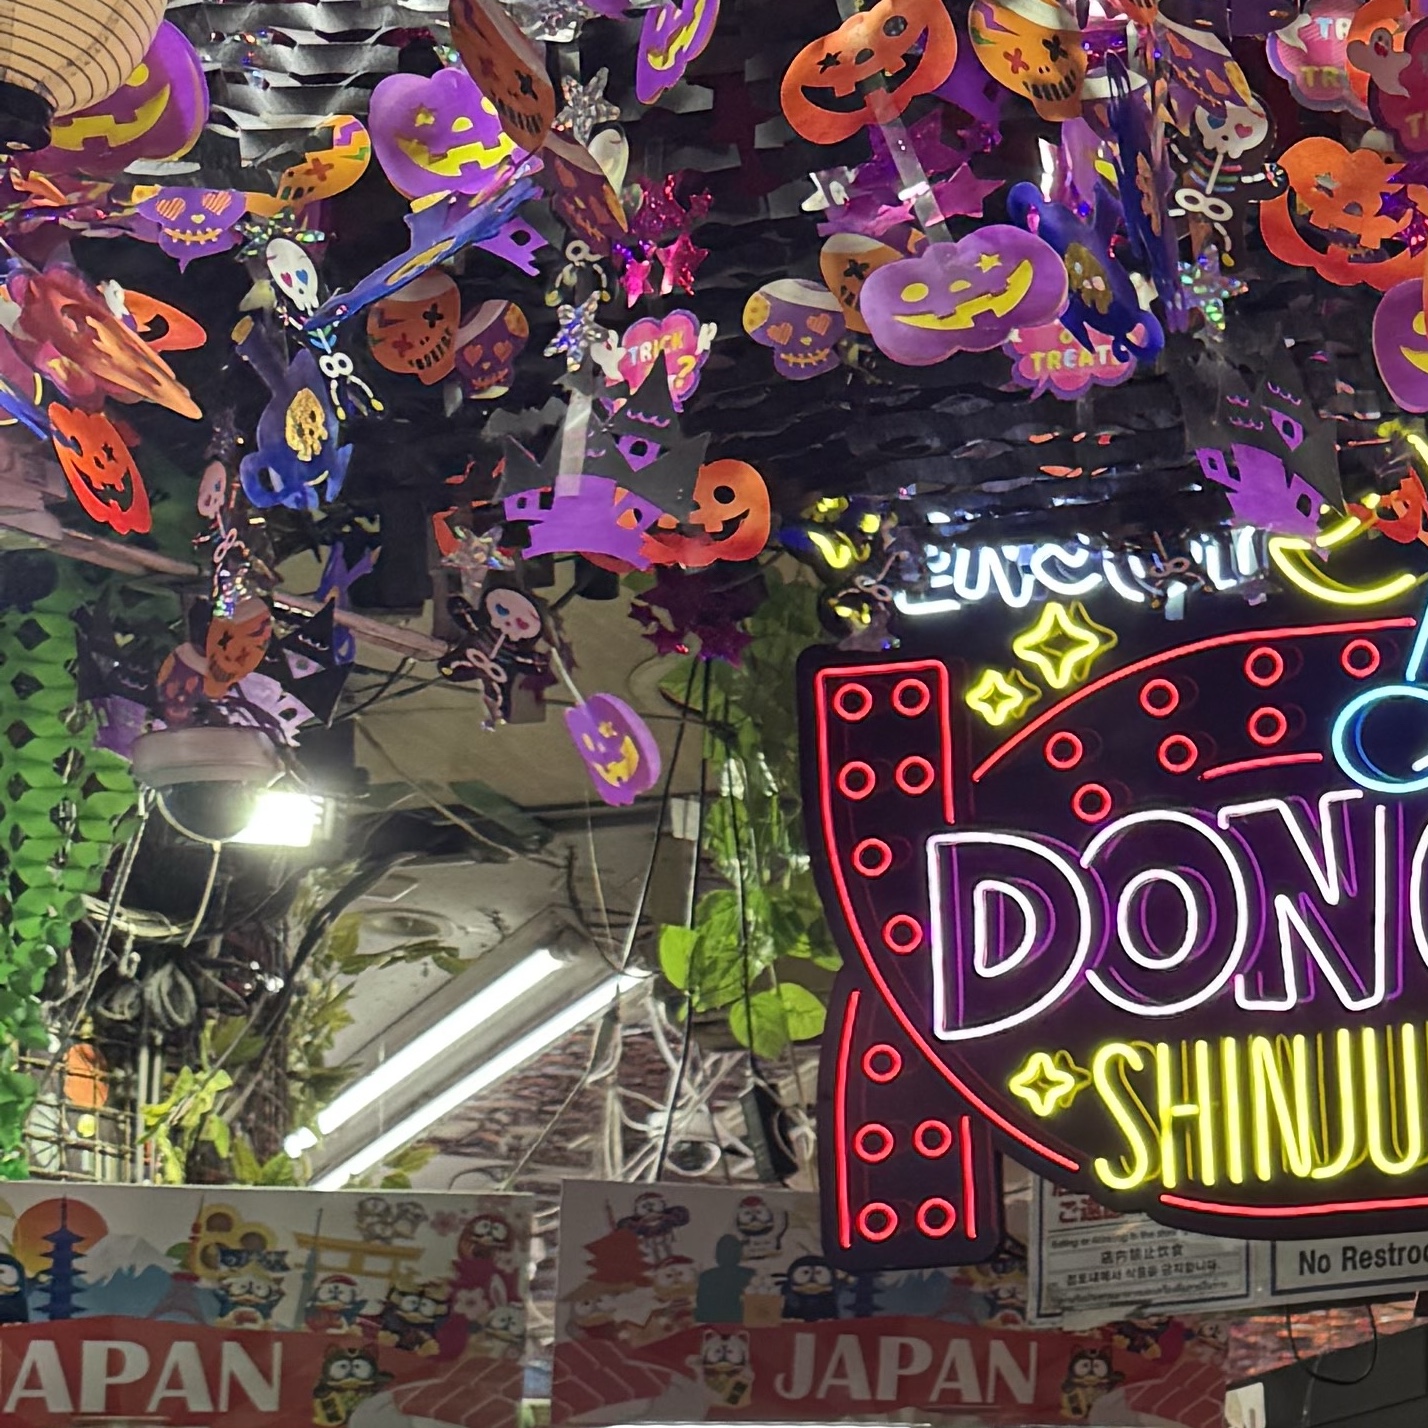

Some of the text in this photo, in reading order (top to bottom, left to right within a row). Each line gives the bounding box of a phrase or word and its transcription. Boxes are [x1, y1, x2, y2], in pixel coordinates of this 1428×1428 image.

[927, 790, 1387, 1041] DON
[1298, 1249, 1332, 1276] No
[774, 1333, 1039, 1404] JAPAN
